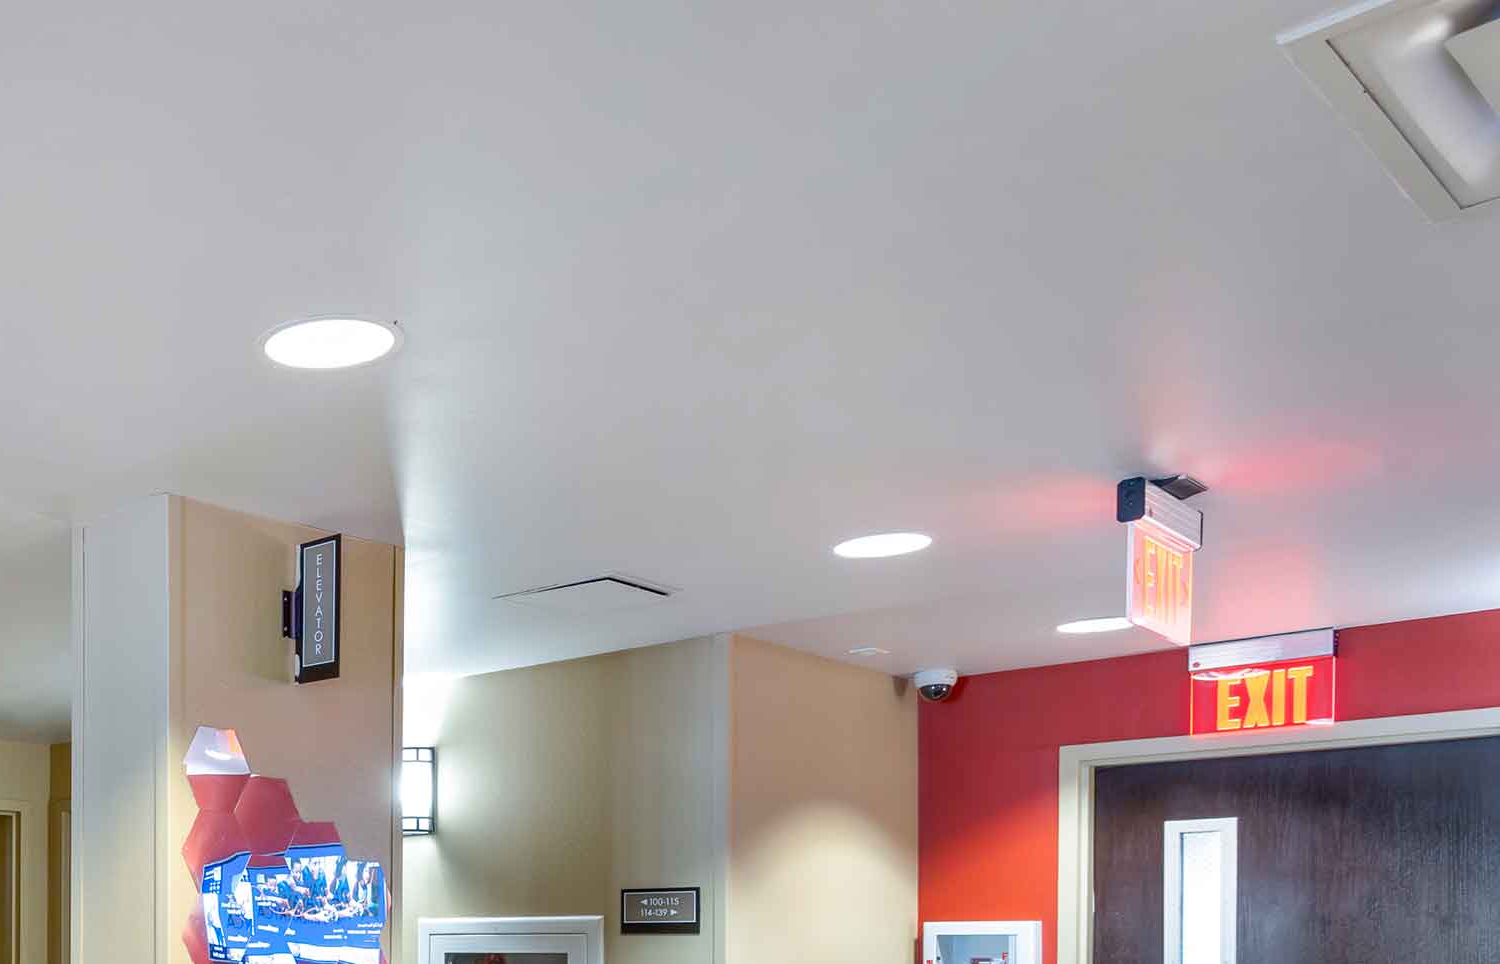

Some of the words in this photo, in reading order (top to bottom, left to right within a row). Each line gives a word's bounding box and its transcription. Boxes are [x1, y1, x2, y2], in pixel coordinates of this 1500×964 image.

[314, 553, 324, 656] ELEVATOR
[1144, 536, 1184, 626] EXIT
[1216, 665, 1315, 731] EXIT
[649, 897, 680, 906] 100-115
